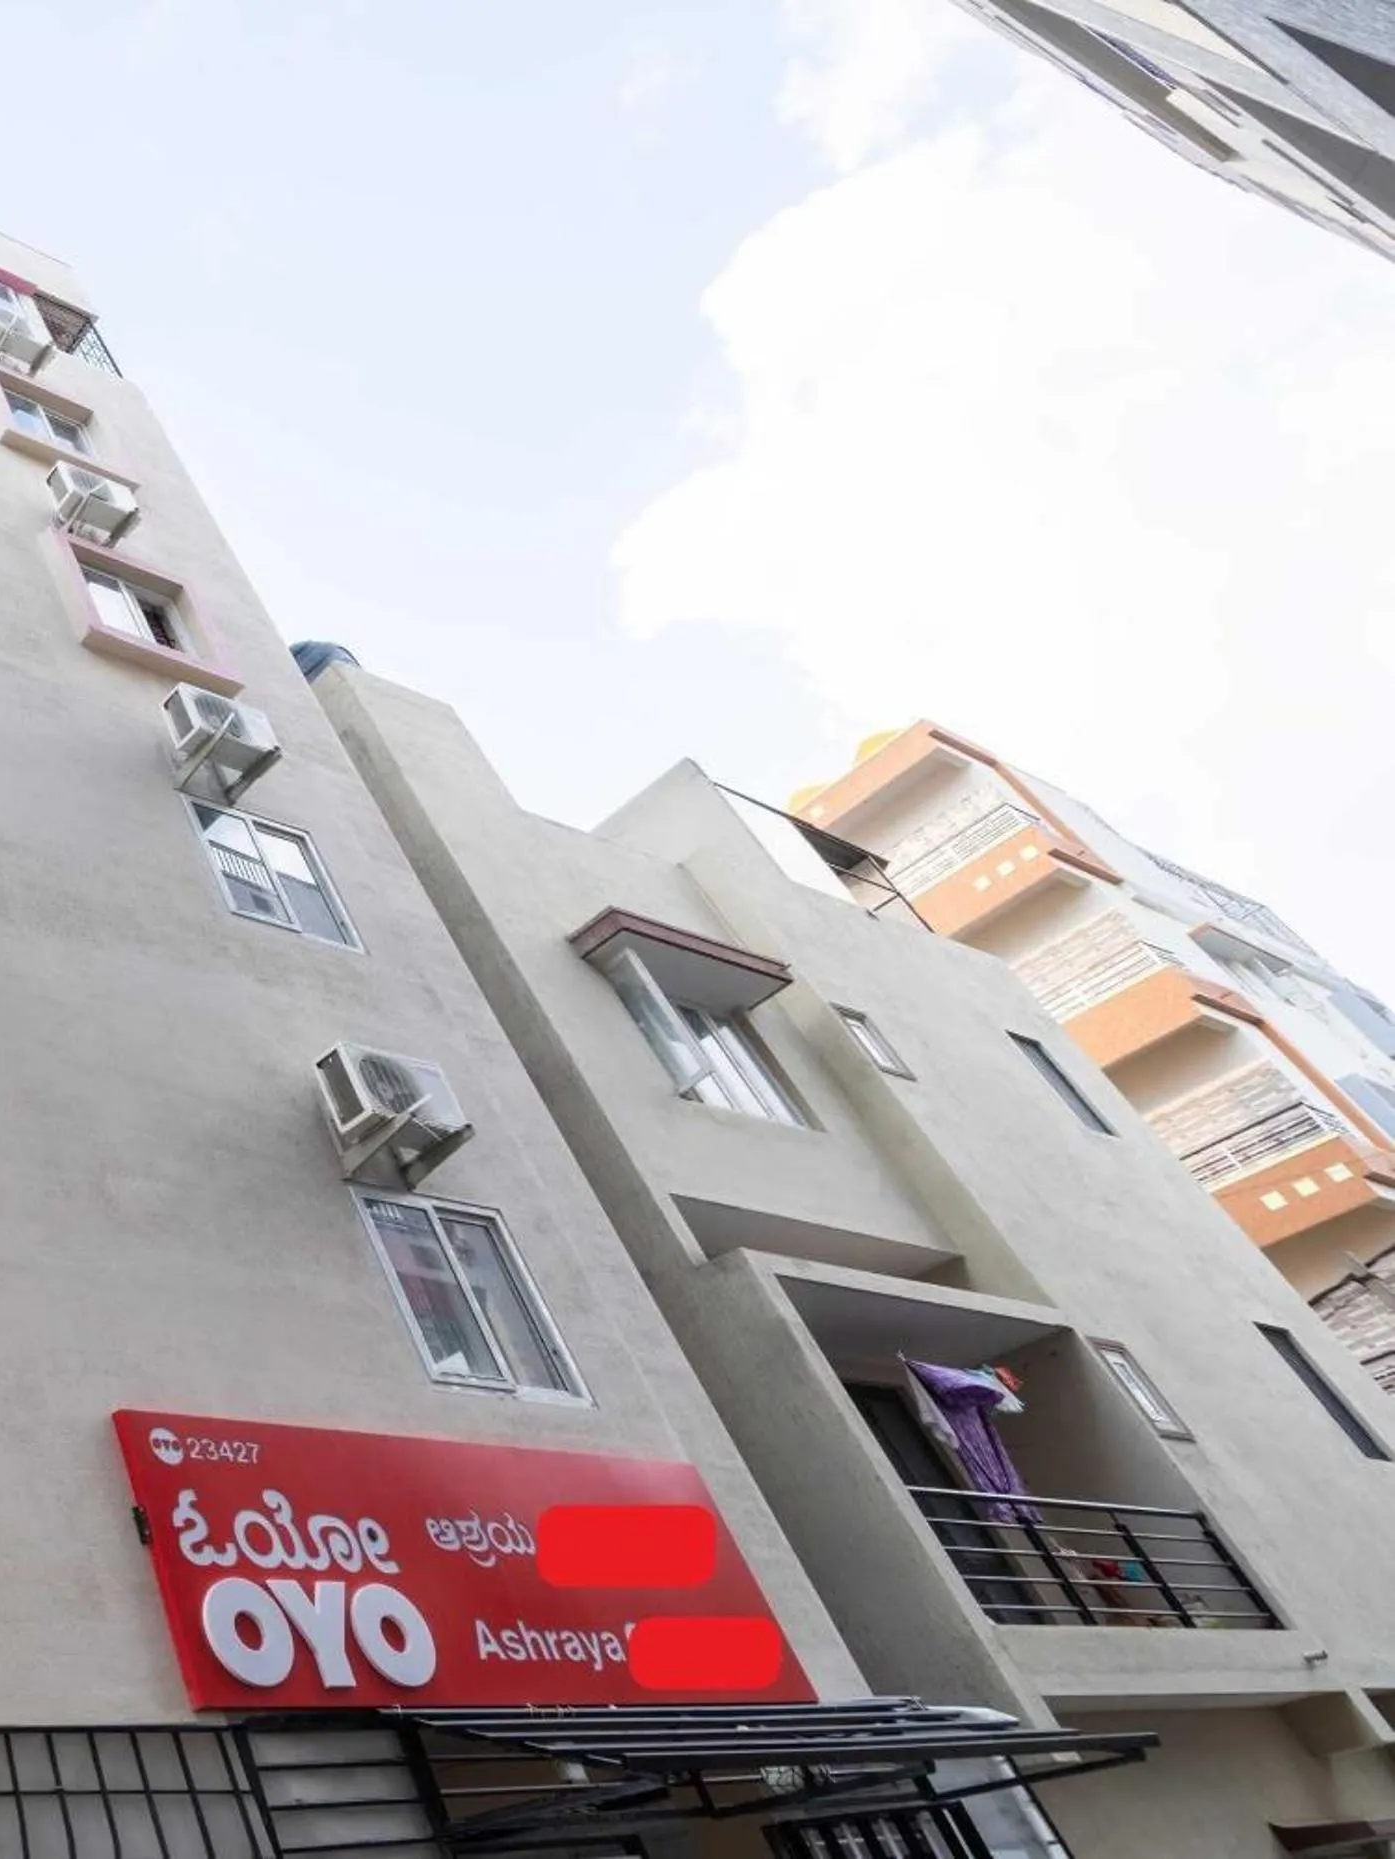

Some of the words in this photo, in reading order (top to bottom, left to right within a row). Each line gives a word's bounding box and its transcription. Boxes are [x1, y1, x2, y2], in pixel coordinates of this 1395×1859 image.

[186, 1437, 259, 1465] 23427
[172, 1488, 400, 1574] ಓಯೋ
[425, 1506, 536, 1568] ಆಶ್ರಯ
[202, 1576, 437, 1689] OYO
[474, 1618, 626, 1671] Ashraya
